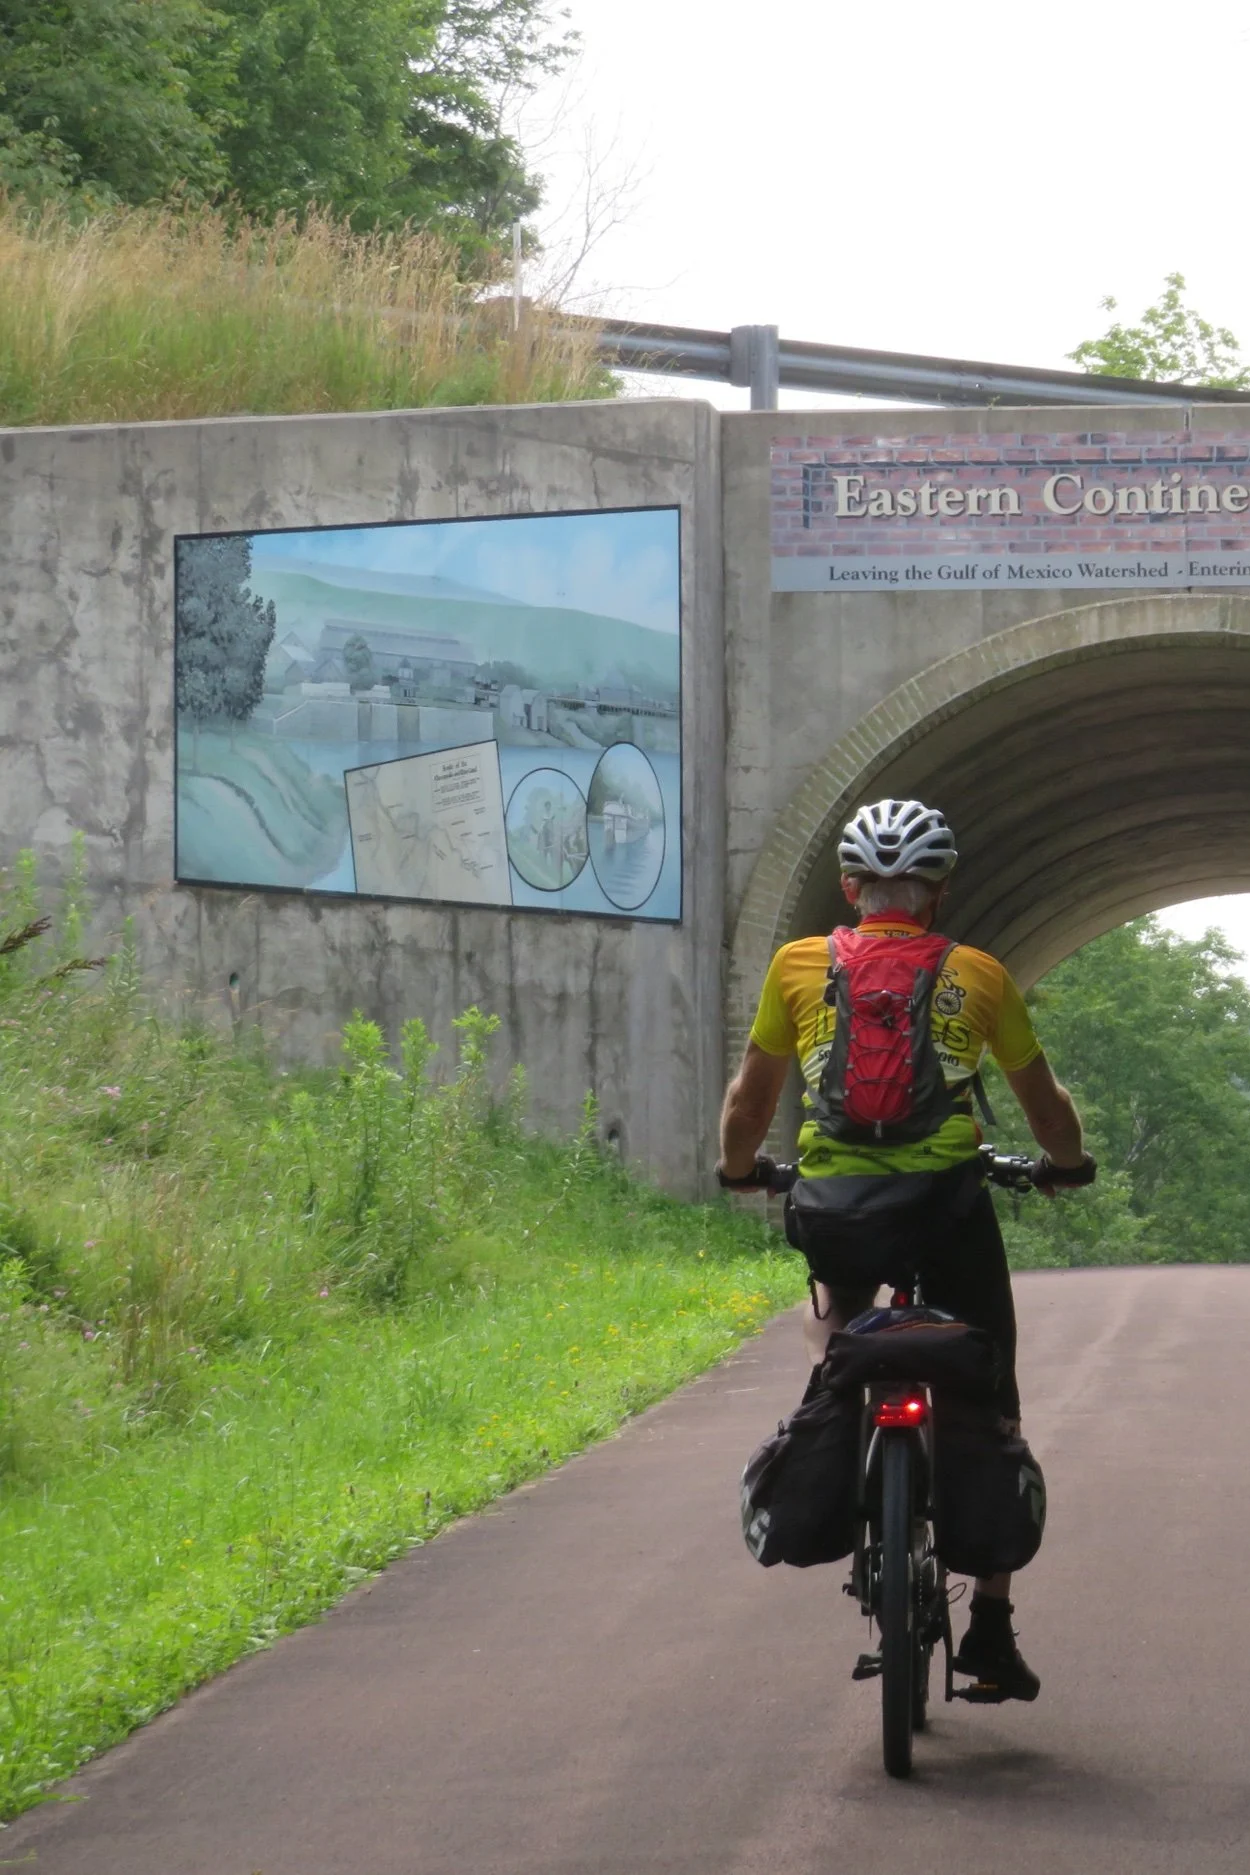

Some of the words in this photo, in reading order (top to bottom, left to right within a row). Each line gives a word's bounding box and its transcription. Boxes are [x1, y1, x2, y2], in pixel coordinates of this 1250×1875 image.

[833, 475, 1022, 519] Eastern
[829, 565, 900, 583] Leaving
[904, 564, 933, 581] the
[937, 563, 978, 581] Gulf
[981, 563, 999, 580] of
[1007, 564, 1072, 580] Mexico
[1077, 561, 1169, 579] Watershed
